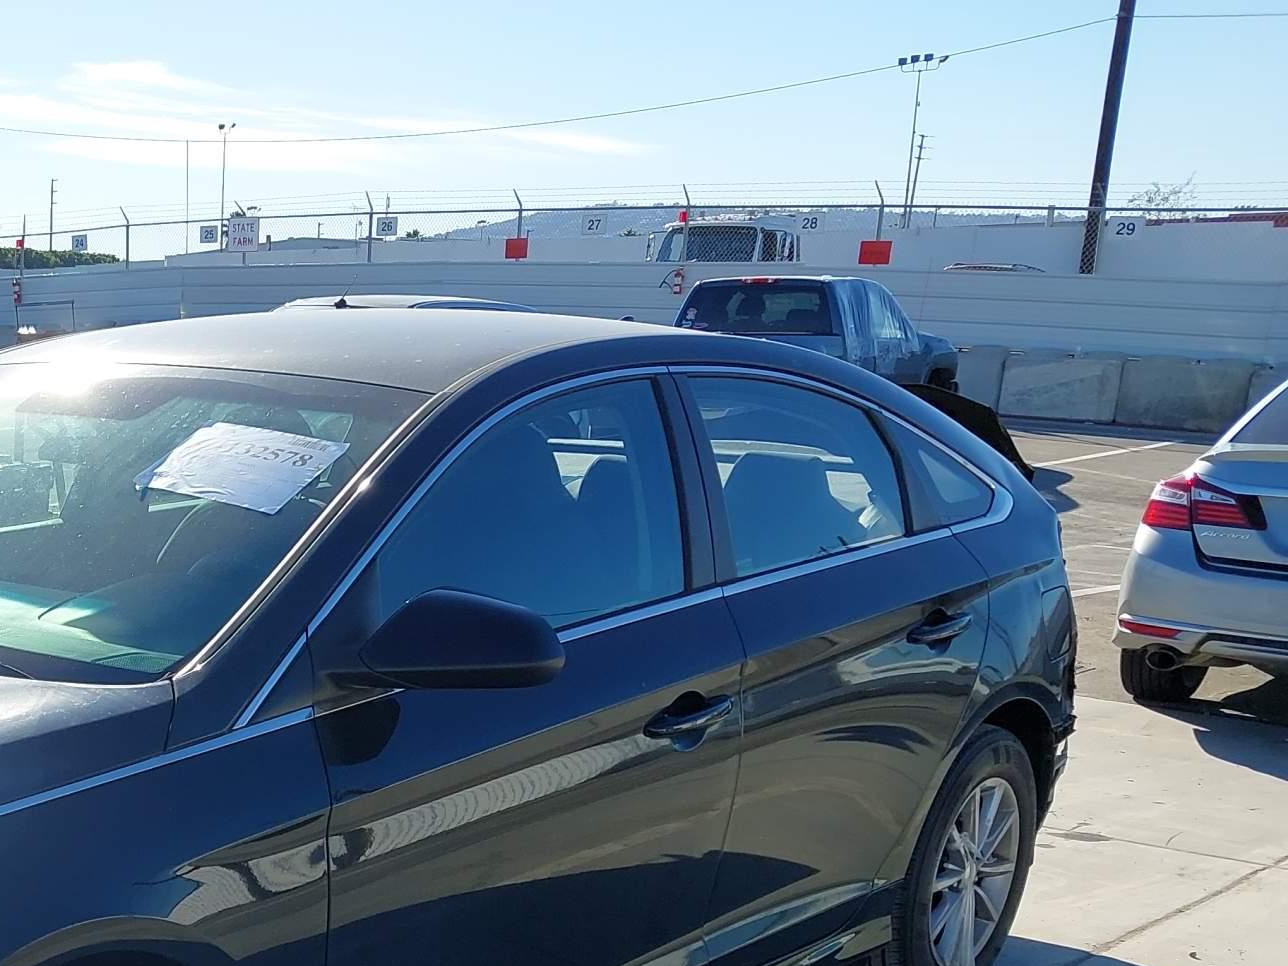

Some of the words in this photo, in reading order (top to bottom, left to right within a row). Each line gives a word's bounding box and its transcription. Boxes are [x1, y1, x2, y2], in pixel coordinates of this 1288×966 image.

[232, 223, 255, 233] STATE
[381, 221, 393, 232] 26
[587, 218, 602, 231] 27
[801, 216, 818, 229] 28
[204, 229, 214, 240] 25
[1115, 222, 1136, 236] 29
[75, 239, 84, 248] 24
[232, 236, 254, 247] FARM
